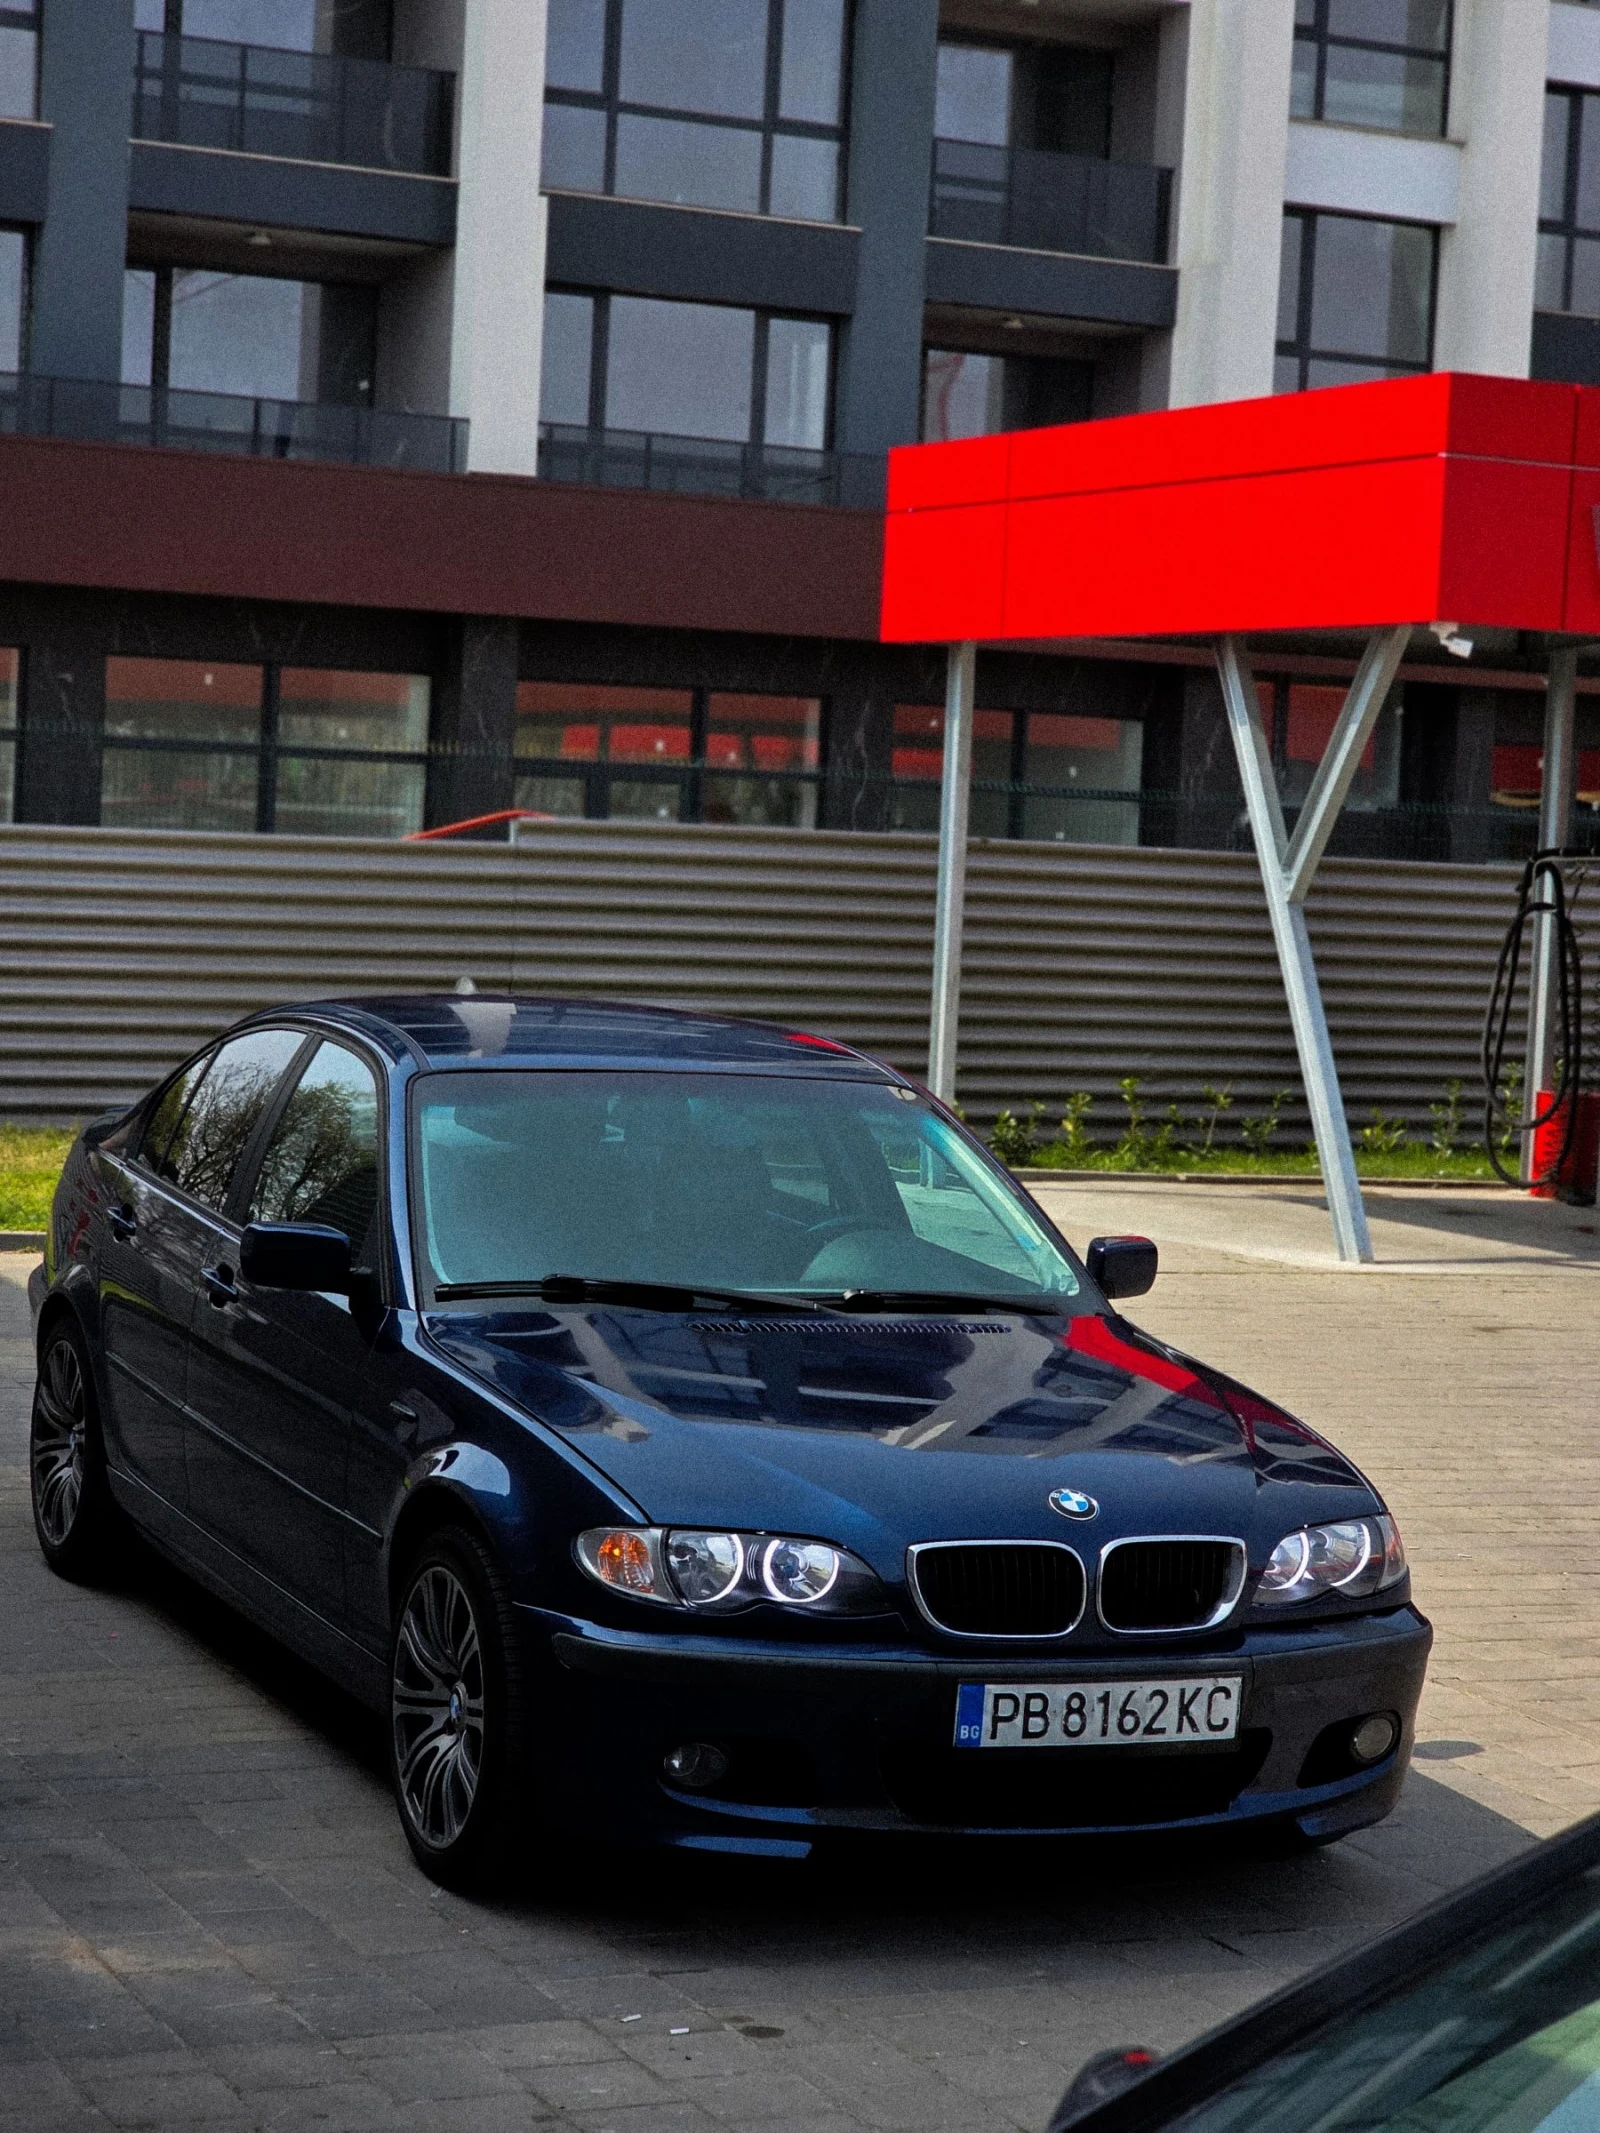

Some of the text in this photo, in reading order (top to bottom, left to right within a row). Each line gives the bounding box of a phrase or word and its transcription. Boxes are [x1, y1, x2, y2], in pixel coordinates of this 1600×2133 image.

[989, 1692, 1050, 1740] PB
[1061, 1689, 1169, 1739] 8162
[960, 1725, 980, 1739] BG
